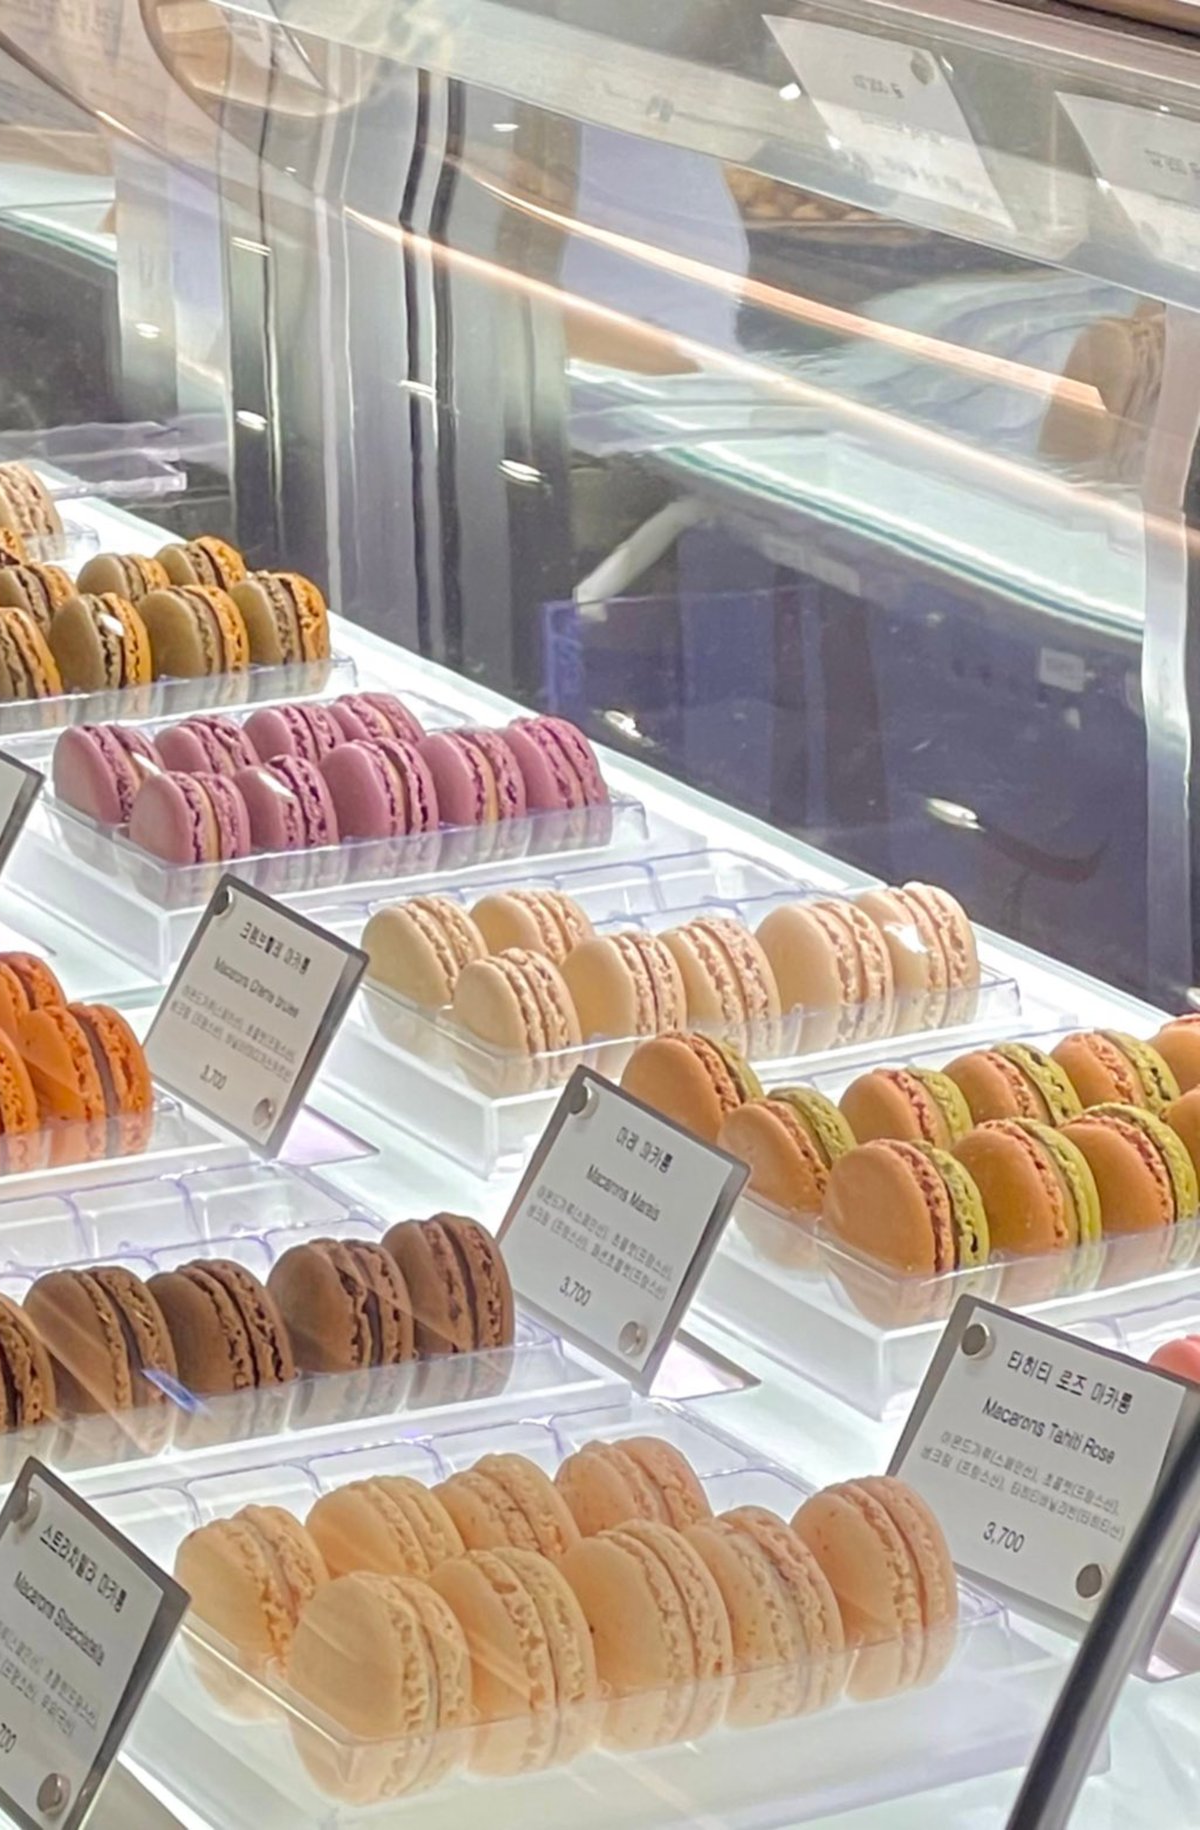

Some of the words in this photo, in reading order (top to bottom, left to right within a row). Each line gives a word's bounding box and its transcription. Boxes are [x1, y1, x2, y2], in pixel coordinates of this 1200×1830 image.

[212, 956, 251, 987] Macarons
[282, 946, 311, 975] 마카롱
[638, 1140, 673, 1173] 마카롱
[585, 1164, 630, 1201] Macarons
[558, 1275, 592, 1307] 3,700
[1006, 1349, 1053, 1383] 타히티
[1055, 1368, 1087, 1395] 로즈
[1089, 1381, 1133, 1414] 마카롱
[981, 1397, 1047, 1436] Macarons
[1046, 1422, 1083, 1450] Tahiti
[1082, 1437, 1116, 1464] Rose
[920, 1445, 952, 1467] 생크림
[981, 1521, 1025, 1554] 3,700
[12, 1570, 57, 1619] Macarons
[95, 1572, 128, 1612] 마카롱
